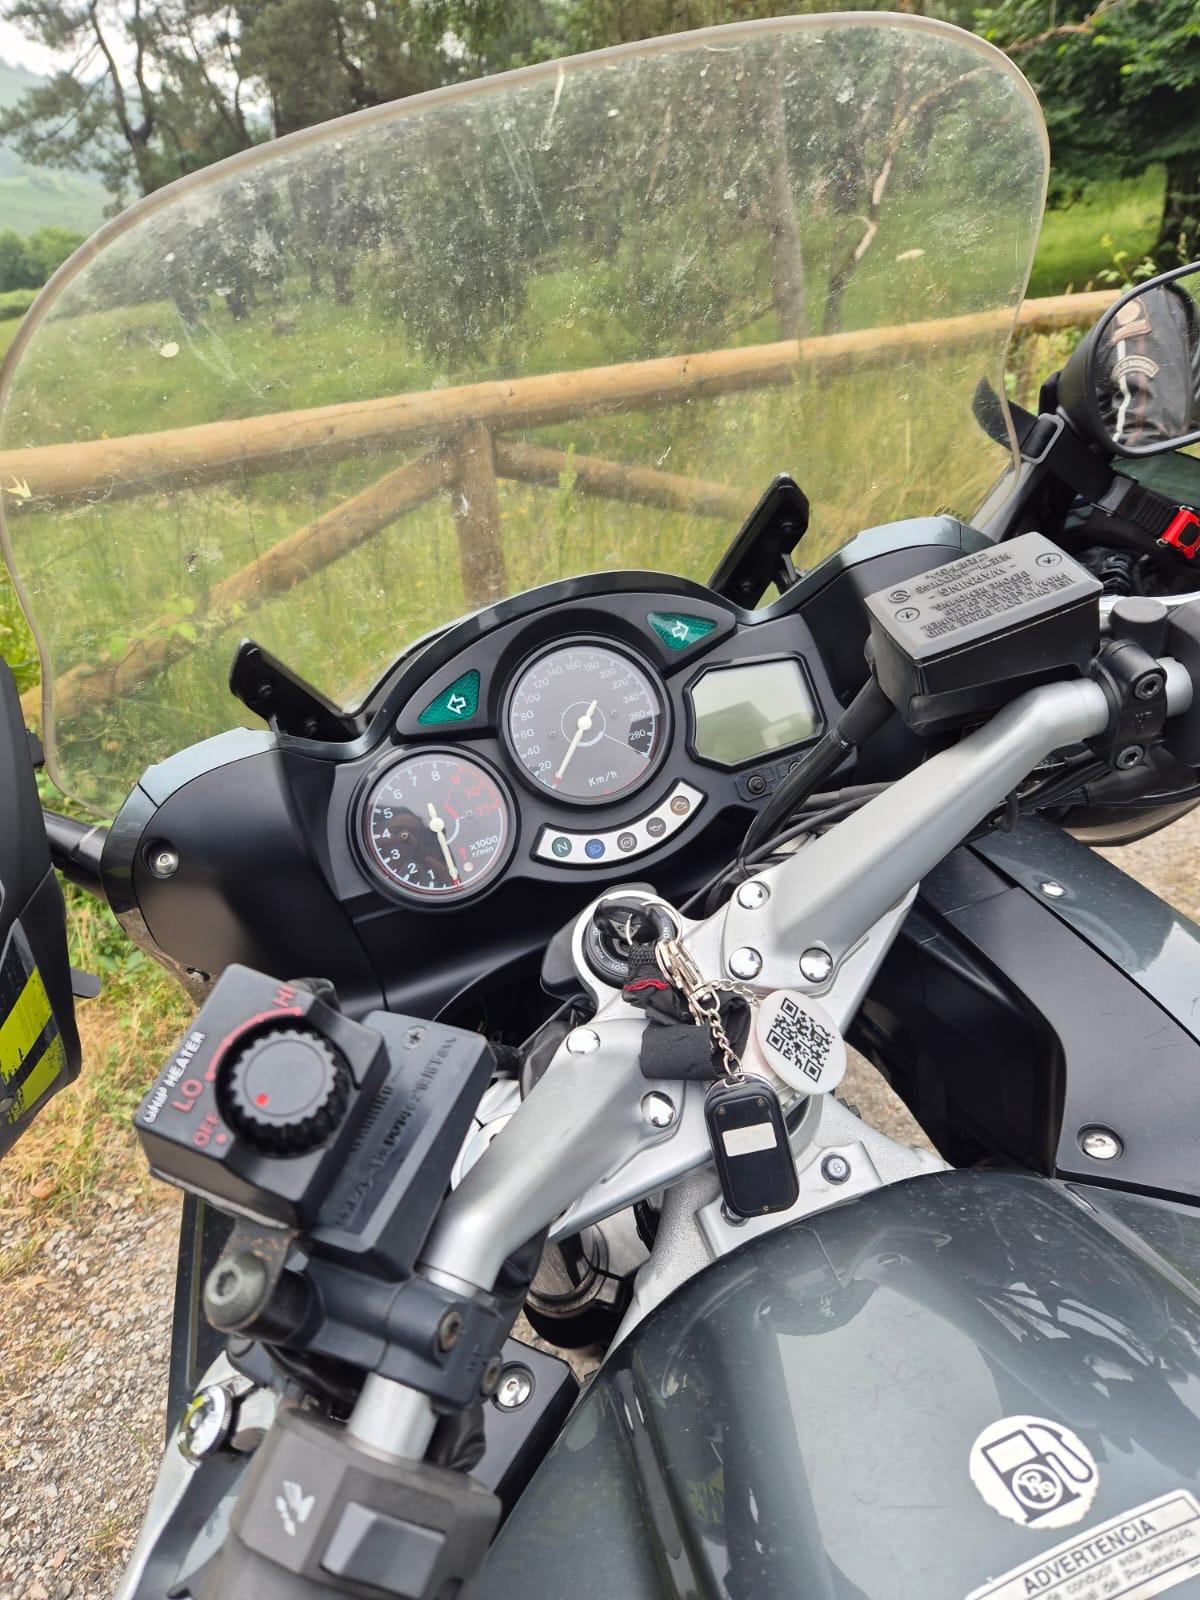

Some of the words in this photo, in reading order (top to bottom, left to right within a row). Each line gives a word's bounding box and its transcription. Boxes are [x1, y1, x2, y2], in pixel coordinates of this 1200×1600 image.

[599, 667, 616, 680] 200
[612, 679, 629, 690] 220
[524, 692, 541, 704] 100
[520, 710, 534, 721] 80
[628, 710, 645, 722] 260
[520, 728, 534, 740] 60
[629, 729, 646, 741] 280
[527, 745, 540, 756] 40
[538, 760, 552, 772] 20
[408, 775, 418, 787] 7
[431, 770, 441, 781] 8
[588, 770, 618, 786] Km/h
[393, 789, 402, 800] 6
[383, 807, 393, 819] 5
[381, 828, 391, 839] 4
[390, 848, 401, 860] 3
[407, 862, 418, 875] 2
[427, 869, 435, 880] 1
[272, 985, 296, 1008] HI
[163, 1031, 206, 1087] HEATER
[171, 1079, 204, 1113] LO
[193, 1111, 220, 1148] OFF
[1024, 1519, 1158, 1594] ADVERTENCIA
